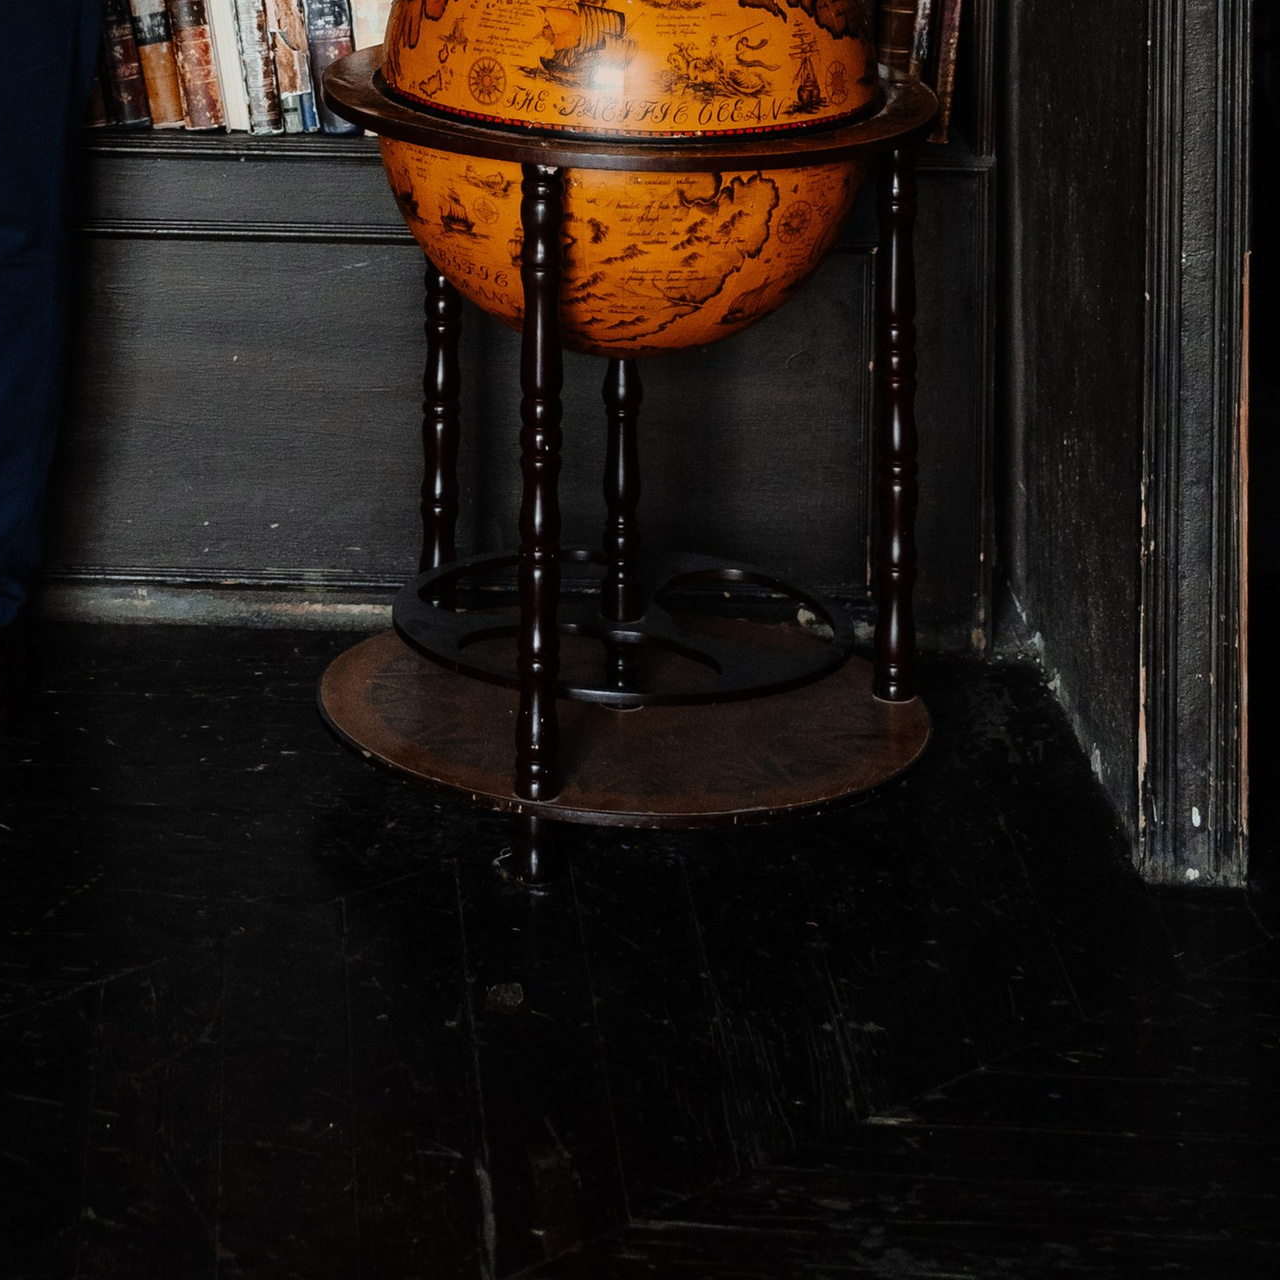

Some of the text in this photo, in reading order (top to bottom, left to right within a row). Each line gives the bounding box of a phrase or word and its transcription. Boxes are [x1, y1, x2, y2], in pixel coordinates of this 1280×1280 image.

[504, 85, 790, 126] THE PACIFIC OCEAN
